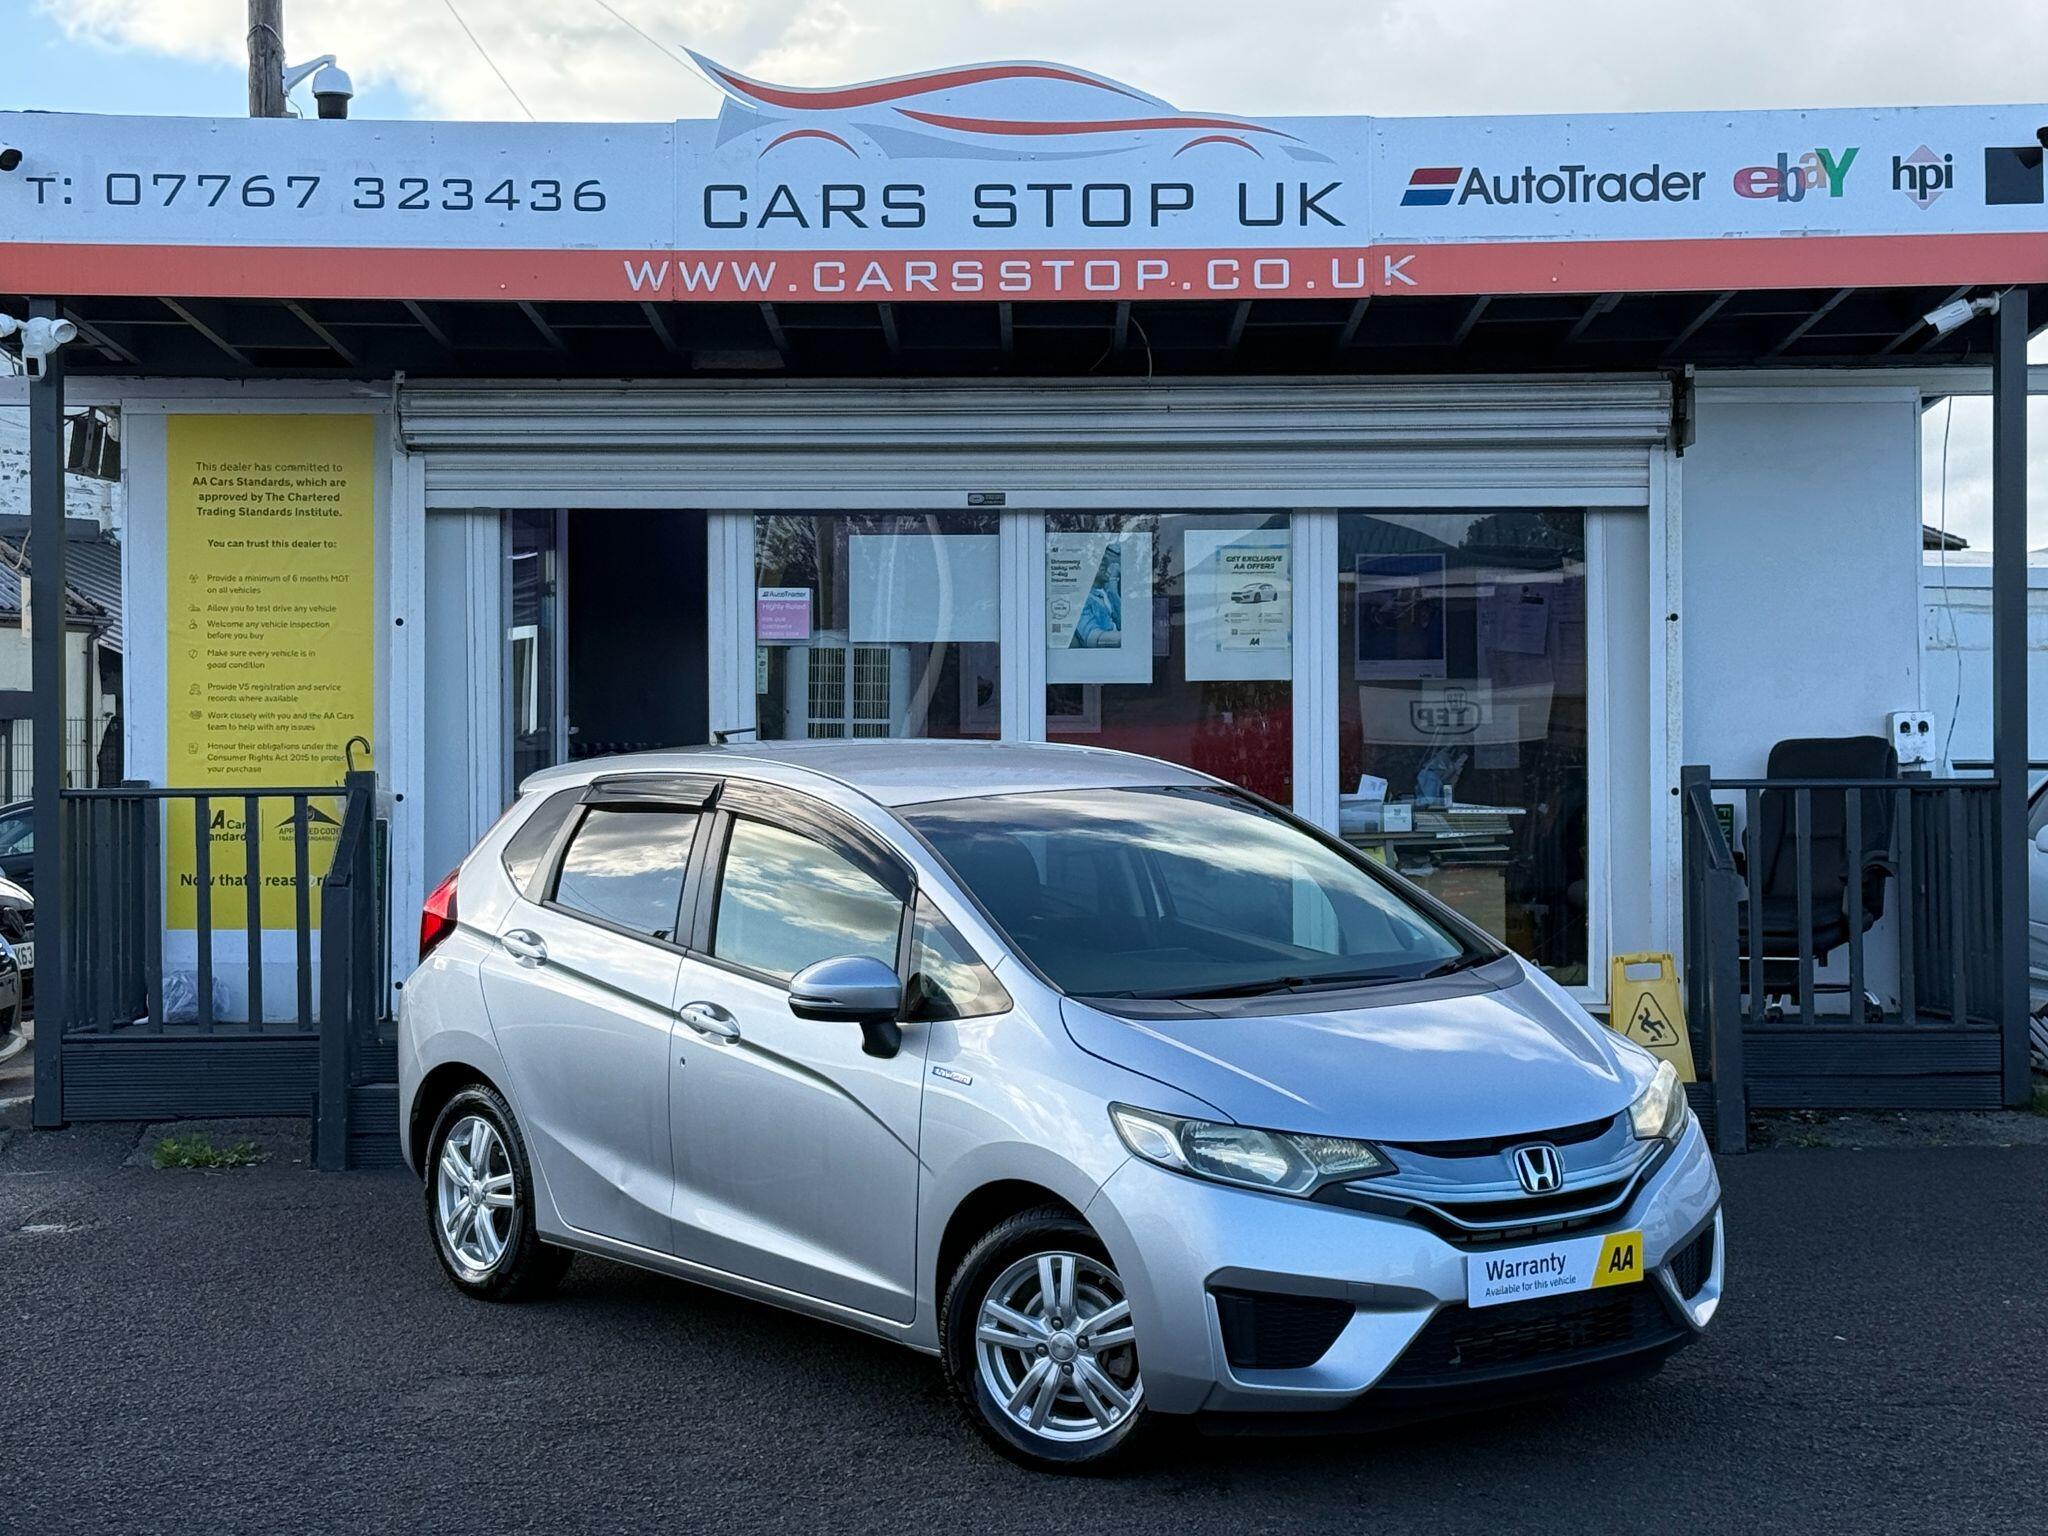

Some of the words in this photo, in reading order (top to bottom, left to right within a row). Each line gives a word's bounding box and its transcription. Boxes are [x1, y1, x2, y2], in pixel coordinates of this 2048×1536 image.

[1458, 163, 1706, 206] AutoTrader
[1892, 153, 1954, 201] hpi
[26, 176, 72, 205] T:
[106, 173, 321, 209] 07767
[353, 176, 608, 212] 323436
[703, 183, 927, 228] CARS
[973, 182, 1195, 228] STOP
[1238, 181, 1347, 228] UK
[623, 254, 1418, 293] WWW.CARSSTOP.CO.UK
[196, 462, 217, 472] This
[220, 462, 251, 472] dealer
[254, 462, 272, 472] has
[275, 462, 330, 472] committed
[332, 464, 343, 472] to
[192, 476, 208, 487] AA
[210, 477, 234, 487] Cars
[236, 477, 294, 488] Standards,
[296, 477, 327, 487] which
[198, 492, 248, 503] approved
[250, 492, 264, 503] by
[264, 492, 285, 502] The
[287, 493, 340, 502] Chartered
[197, 507, 236, 518] Trading
[238, 507, 293, 516] Standards
[295, 507, 343, 517] Institute.
[207, 539, 225, 548] You
[246, 540, 269, 548] trust
[271, 540, 290, 548] this
[291, 540, 322, 548] dealer
[323, 540, 337, 548] to:
[330, 574, 349, 582] MOT
[320, 753, 345, 763] protec
[226, 820, 246, 830] Car
[1485, 1252, 1567, 1282] Warranty
[1608, 1244, 1634, 1274] AA
[1485, 1281, 1521, 1297] Available
[1522, 1280, 1534, 1291] for
[1534, 1278, 1549, 1290] this
[1549, 1274, 1577, 1288] vehicle
